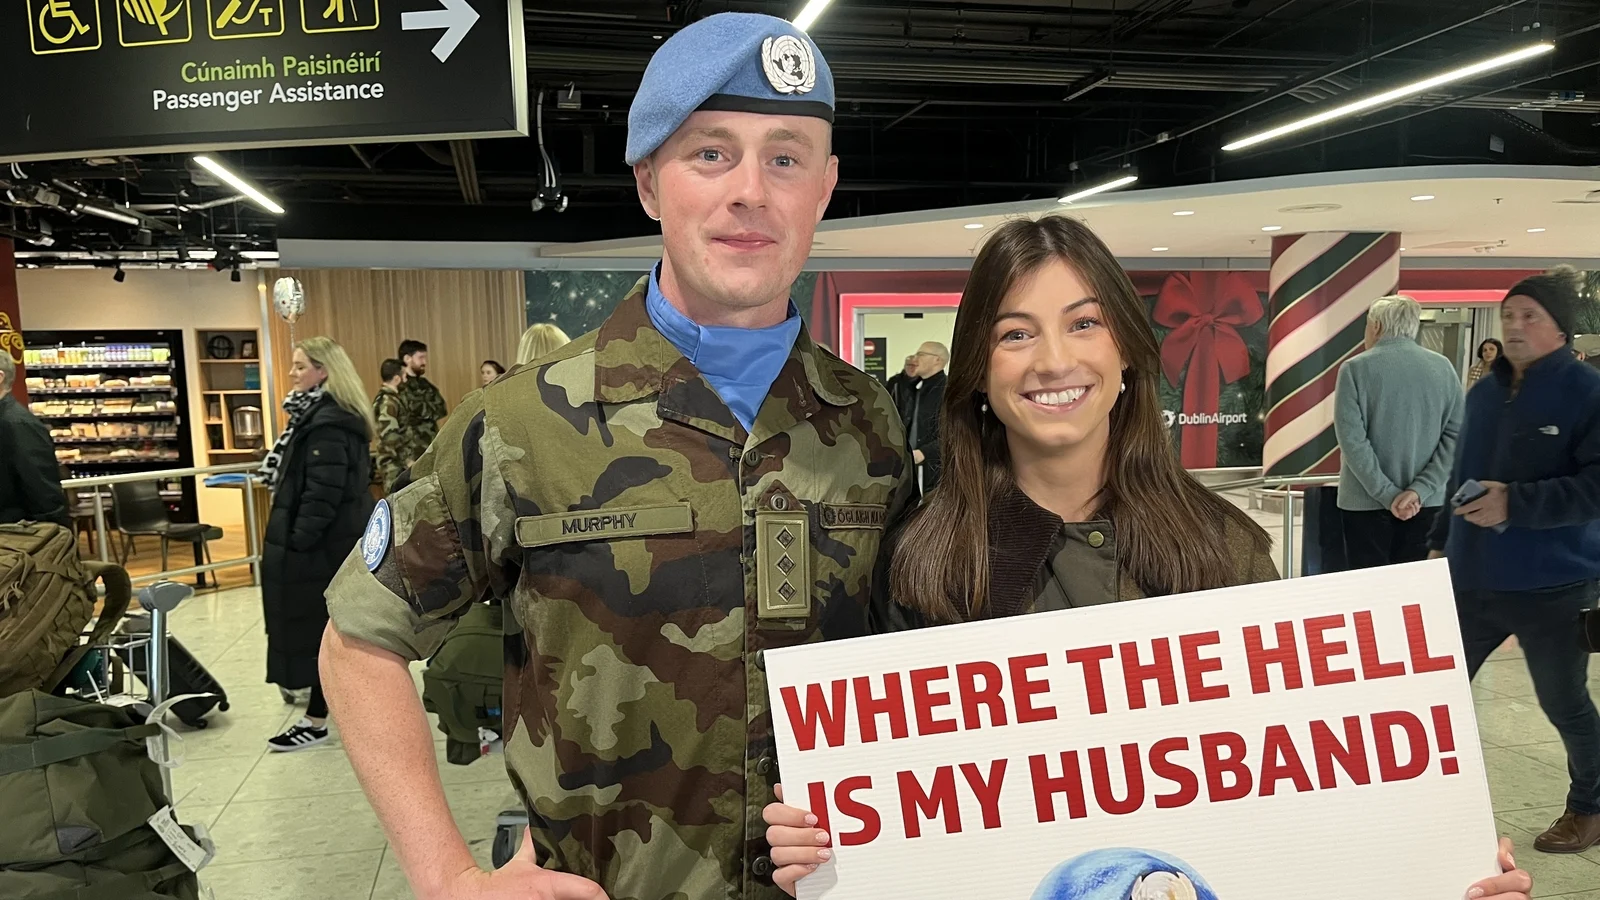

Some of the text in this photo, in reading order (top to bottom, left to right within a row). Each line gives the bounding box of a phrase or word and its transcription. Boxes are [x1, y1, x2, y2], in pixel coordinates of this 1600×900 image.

[181, 51, 382, 83] Cúnaimh Paisinéirí
[153, 81, 385, 112] Passenger Assistance
[1178, 412, 1248, 426] DublinAirport
[562, 513, 637, 535] MURPHY
[780, 604, 1455, 751] WHERE THE HELL
[807, 705, 1461, 848] IS MY HUSBAND!
